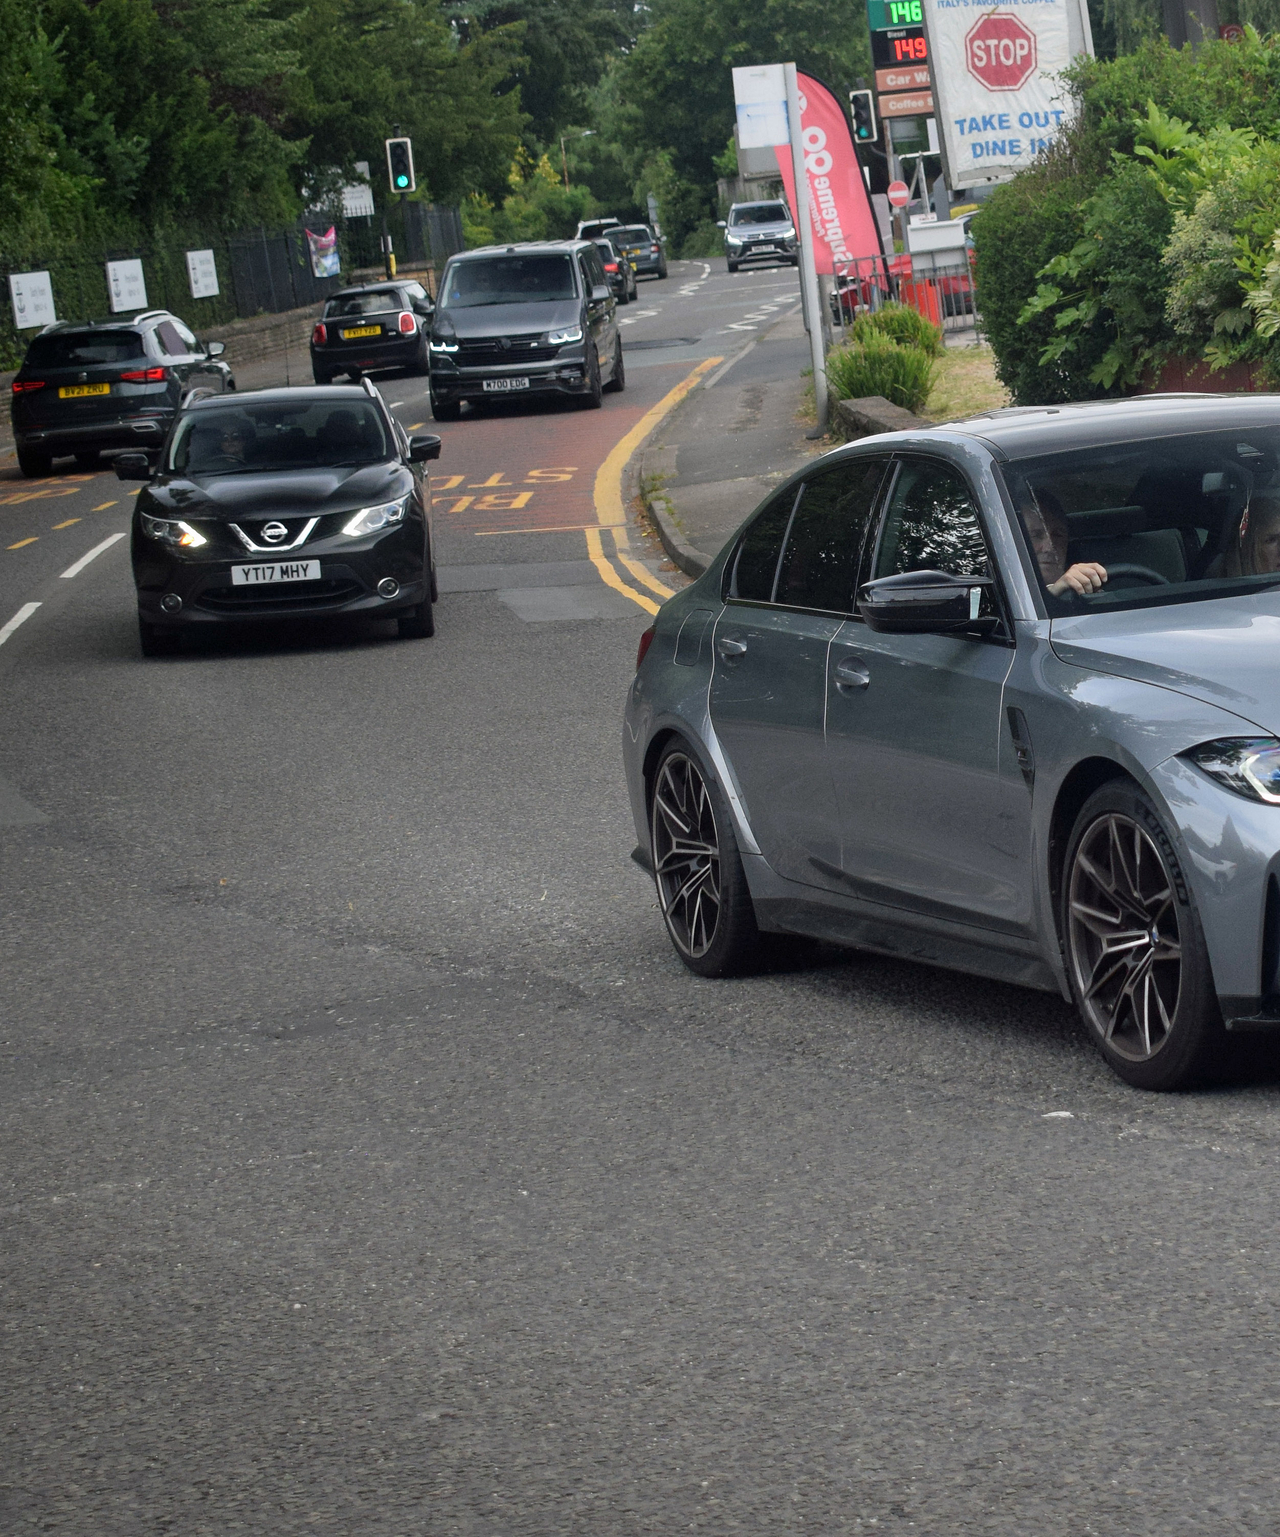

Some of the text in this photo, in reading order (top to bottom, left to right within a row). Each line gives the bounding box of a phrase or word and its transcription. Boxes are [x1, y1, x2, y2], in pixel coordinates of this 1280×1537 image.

[890, 1, 922, 24] 146
[894, 37, 927, 60] 149
[972, 38, 1029, 67] STOP
[886, 74, 911, 86] Car
[889, 98, 924, 110] Coffee
[955, 109, 1065, 135] TAKE OUT
[971, 138, 1053, 158] DINE IN
[430, 467, 579, 491] STO
[432, 491, 534, 513] BU
[242, 563, 309, 582] YT17 MHY
